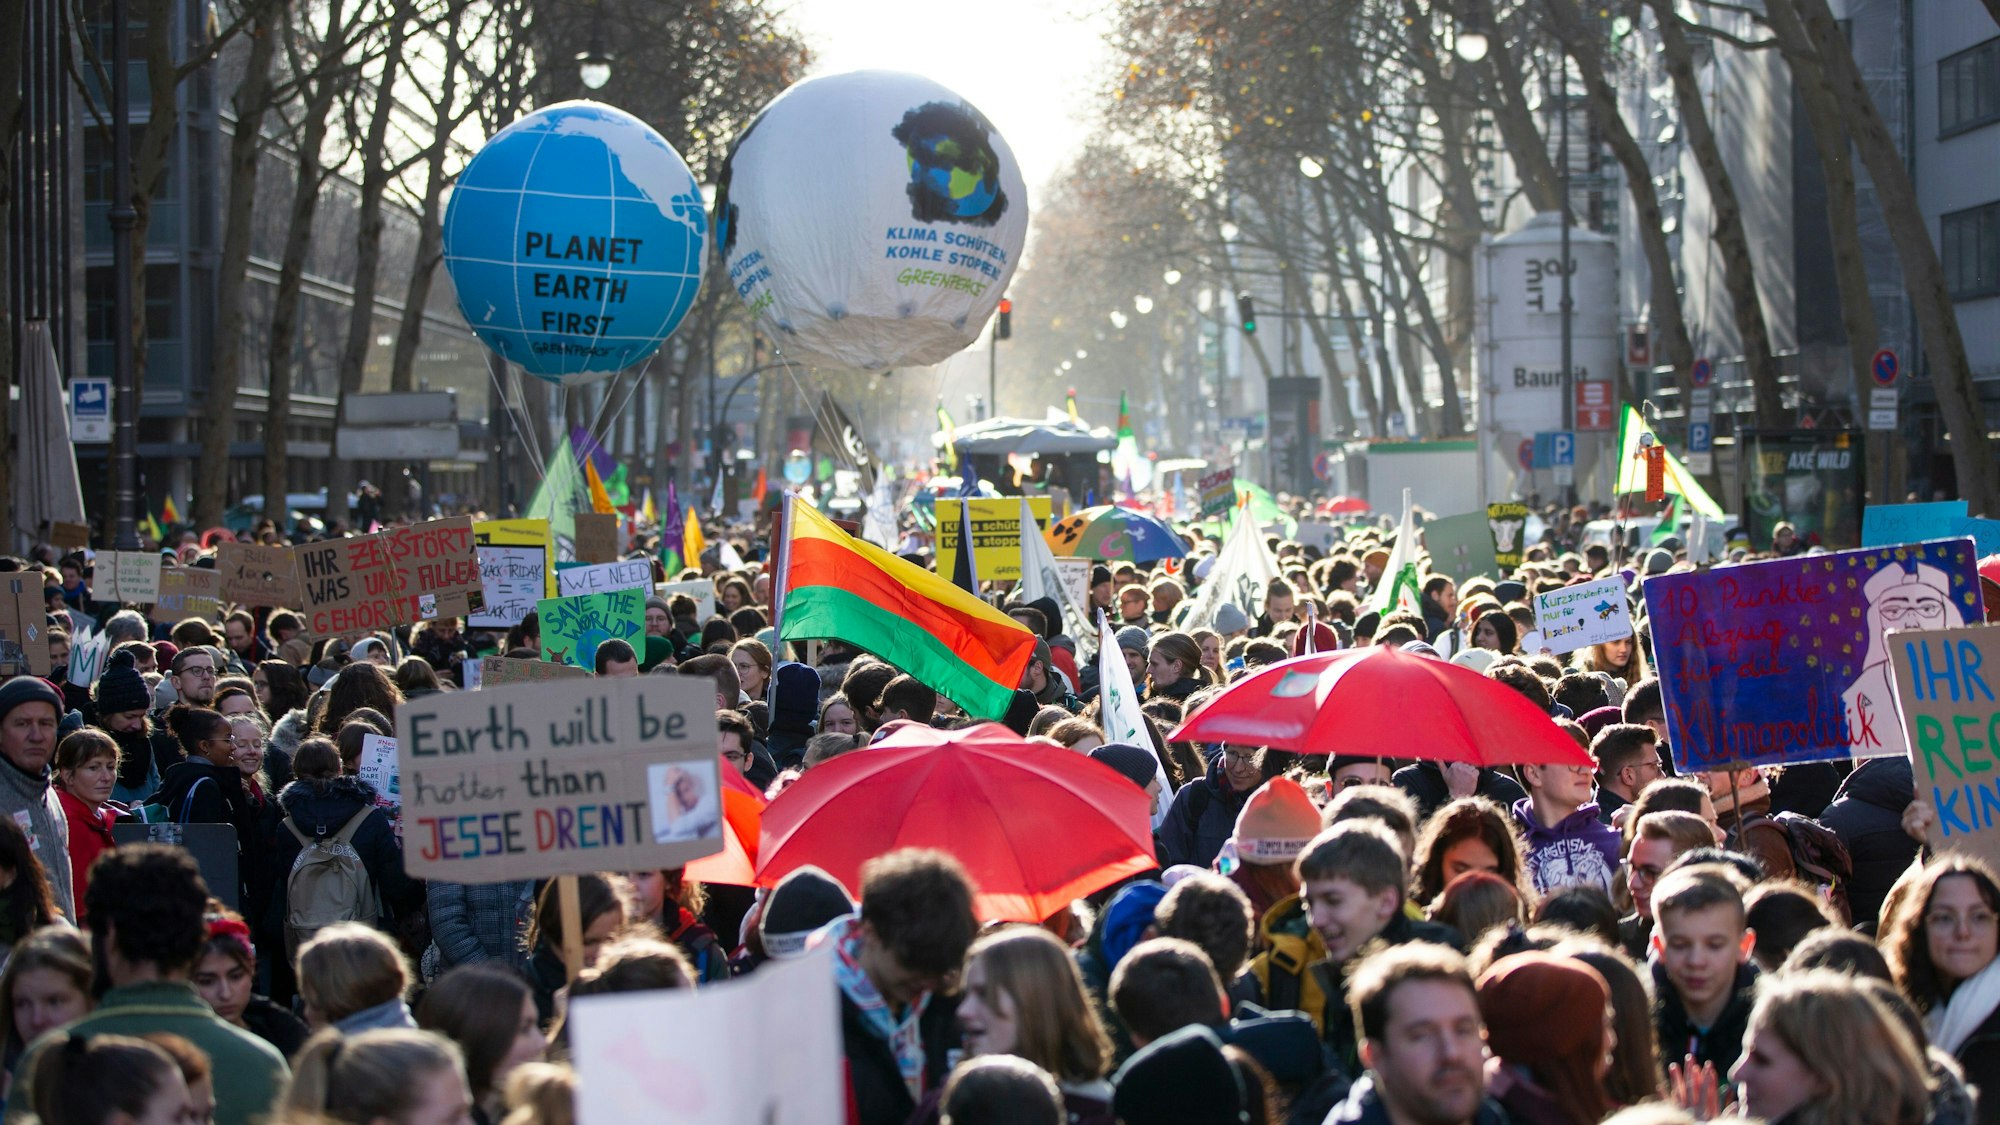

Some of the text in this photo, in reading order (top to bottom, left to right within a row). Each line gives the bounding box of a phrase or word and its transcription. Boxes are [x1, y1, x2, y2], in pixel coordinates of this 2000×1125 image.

[525, 231, 643, 264] PLANET
[886, 227, 937, 242] KLIMA
[885, 246, 943, 262] KOHLE
[534, 273, 628, 303] EARTH
[897, 267, 987, 297] GREENPEACE
[541, 311, 614, 337] FIRST
[532, 341, 616, 357] GREENPEACE
[1788, 452, 1815, 469] AXE
[1817, 451, 1850, 469] WILD
[303, 549, 340, 578] IHR
[564, 562, 651, 590] WE NEED
[307, 577, 350, 605] WAS
[364, 568, 410, 597] UNS
[418, 559, 480, 591] ALLEN
[1660, 576, 1822, 618] 10 Punkte
[313, 594, 421, 634] GEHÖRT!
[545, 593, 636, 635] SAVE THE
[562, 610, 626, 641] WORLD
[1543, 608, 1574, 622] nur für
[1543, 618, 1585, 640] Insekten!
[1672, 619, 1790, 662] Abzug
[1676, 657, 1790, 694] für die
[1905, 639, 1995, 703] IHR
[410, 694, 687, 757] Earth will be
[1669, 686, 1882, 766] Klimapolitik
[377, 739, 396, 748] #Neu
[413, 759, 607, 807] hotter than
[417, 811, 526, 861] JESSE
[535, 802, 647, 852] DRENT
[1537, 838, 1594, 860] FASCISM
